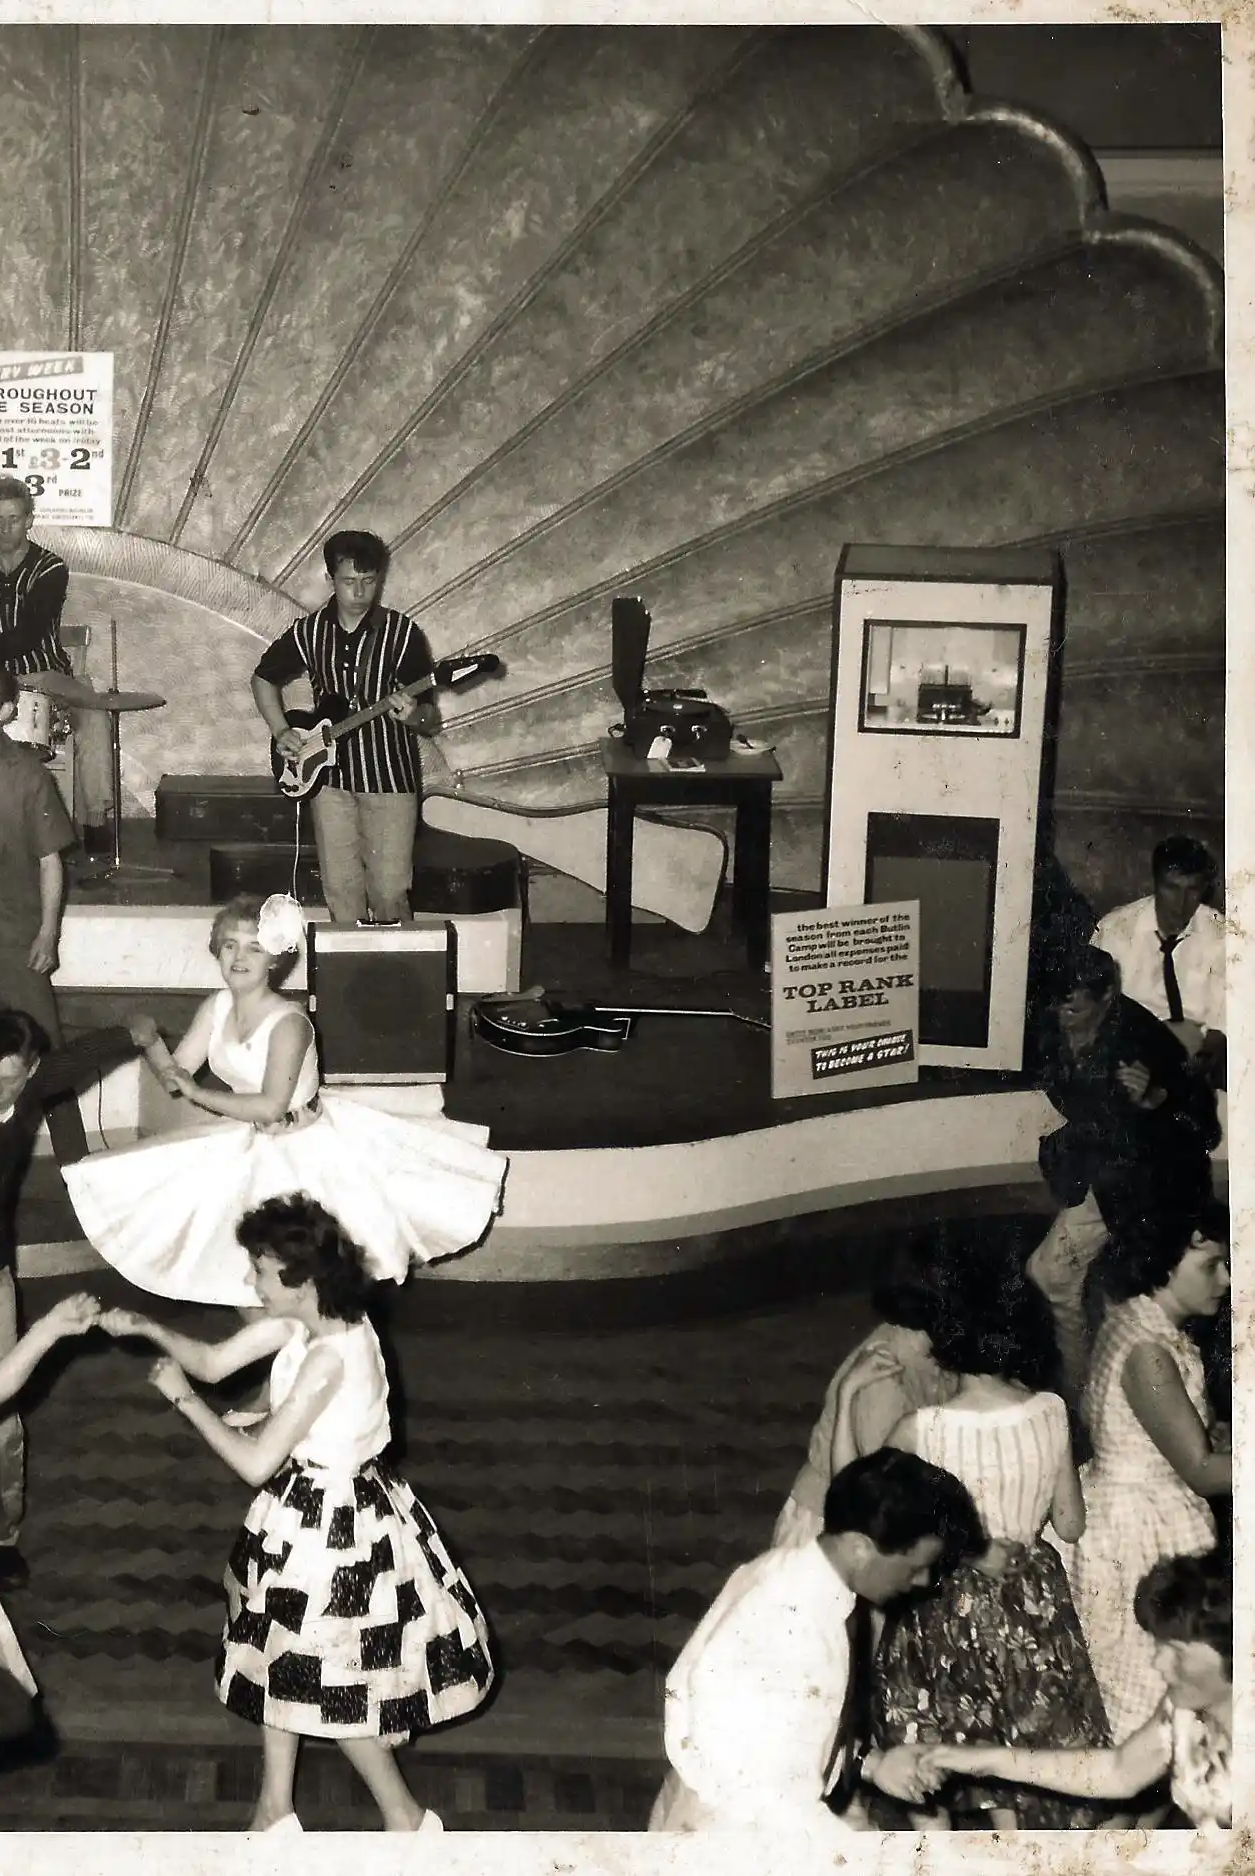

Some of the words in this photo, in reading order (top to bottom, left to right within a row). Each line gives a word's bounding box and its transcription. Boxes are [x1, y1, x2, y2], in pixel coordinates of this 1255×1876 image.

[27, 358, 75, 377] WEEK
[19, 402, 94, 415] SEASON
[58, 488, 82, 497] PRIZE
[797, 923, 815, 932] the
[817, 921, 839, 930] best
[841, 916, 878, 927] winner
[879, 914, 889, 923] of
[892, 913, 910, 922] the
[786, 934, 823, 943] season
[826, 930, 851, 939] from
[853, 926, 879, 936] each
[880, 923, 910, 933] Butlin
[785, 952, 823, 963] London
[824, 949, 837, 958] all
[838, 946, 885, 958] expenses
[886, 942, 910, 953] paid
[788, 943, 817, 954] Camp
[819, 940, 836, 950] will
[837, 938, 849, 947] be
[853, 935, 892, 946] brought
[895, 933, 906, 942] to
[789, 964, 800, 973] to
[801, 960, 828, 971] make
[837, 956, 872, 968] record
[874, 954, 887, 964] for
[889, 953, 908, 962] the
[783, 982, 833, 1000] TOP
[838, 974, 914, 994] RANK
[806, 992, 889, 1013] LABEL
[815, 1047, 837, 1059] THIS
[851, 1040, 876, 1052] YOUR
[816, 1062, 827, 1072] TO
[828, 1053, 865, 1069] BECOME
[867, 1052, 874, 1061] A
[877, 1042, 910, 1060] STAR!
